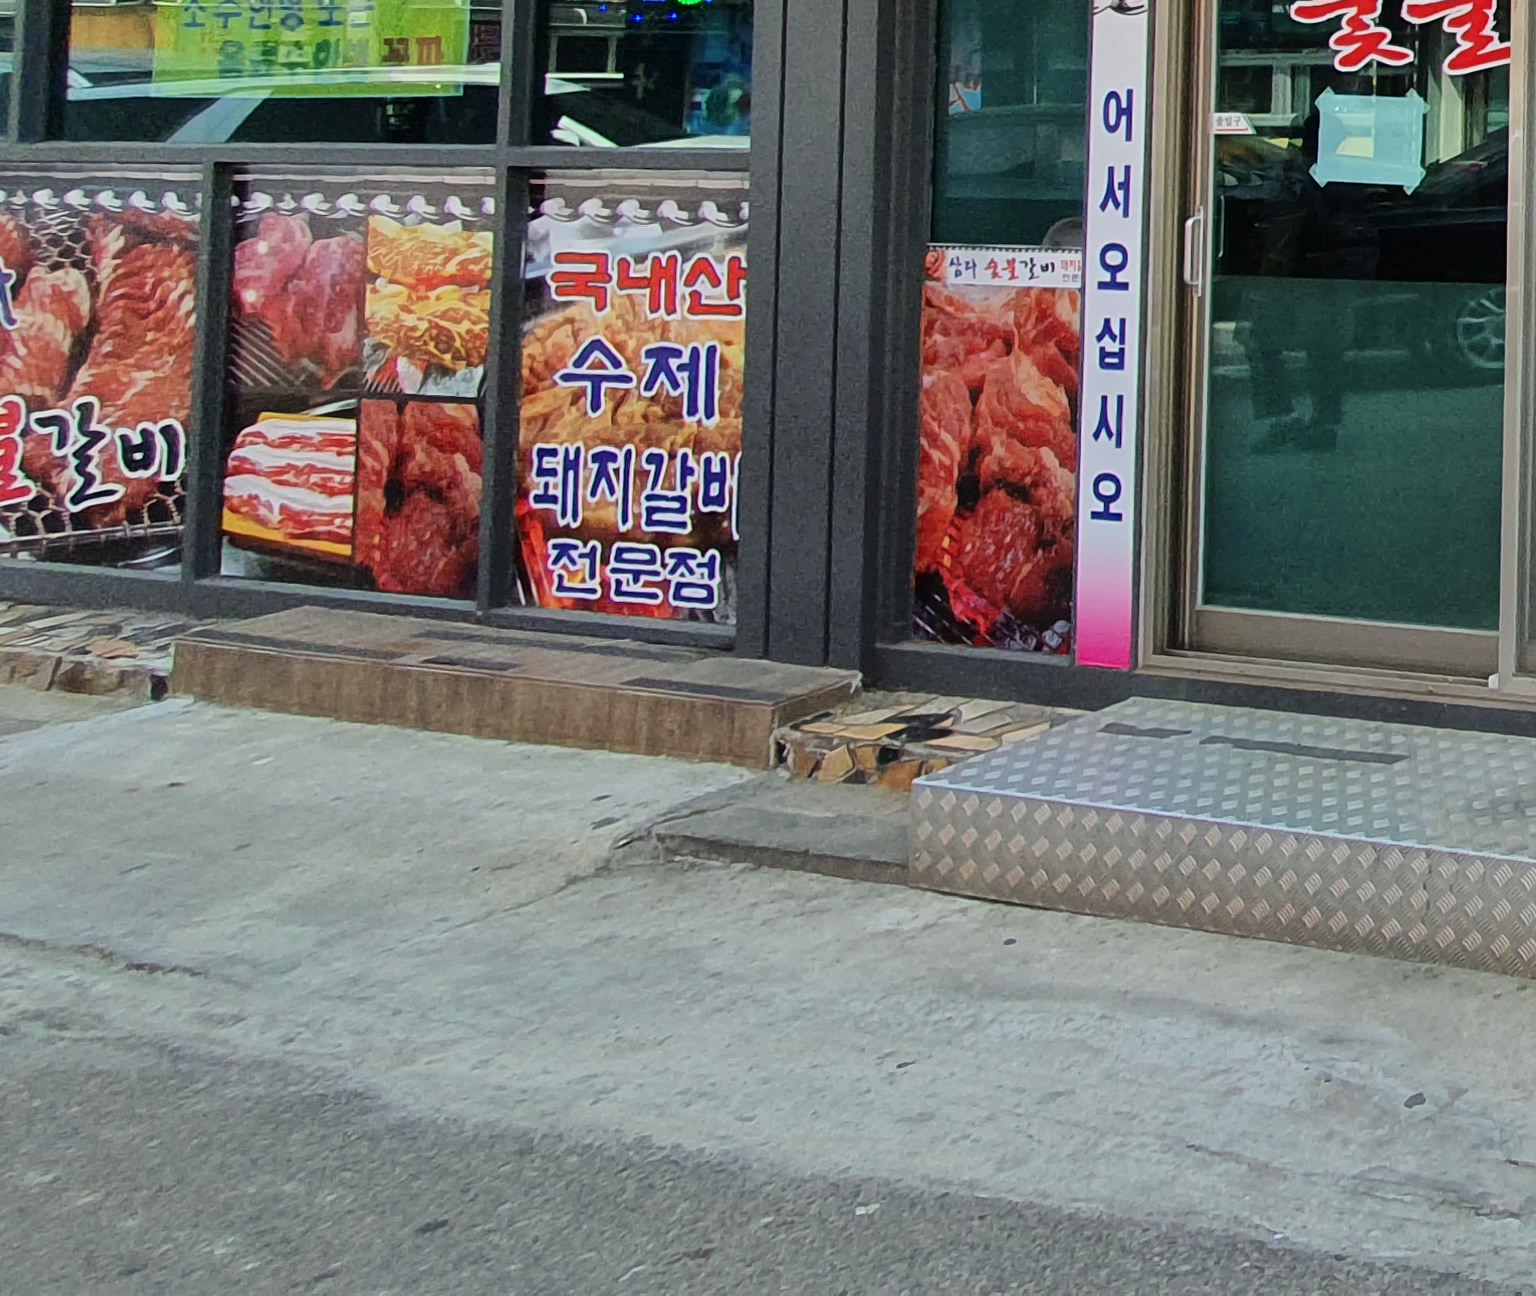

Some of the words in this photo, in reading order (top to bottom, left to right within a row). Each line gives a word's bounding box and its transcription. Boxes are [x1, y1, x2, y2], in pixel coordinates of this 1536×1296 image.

[550, 250, 747, 320] 국내산
[949, 256, 977, 280] 삼다
[1090, 87, 1134, 523] 어서오십시오
[553, 335, 721, 426] 수제
[548, 538, 721, 610] 전문점
